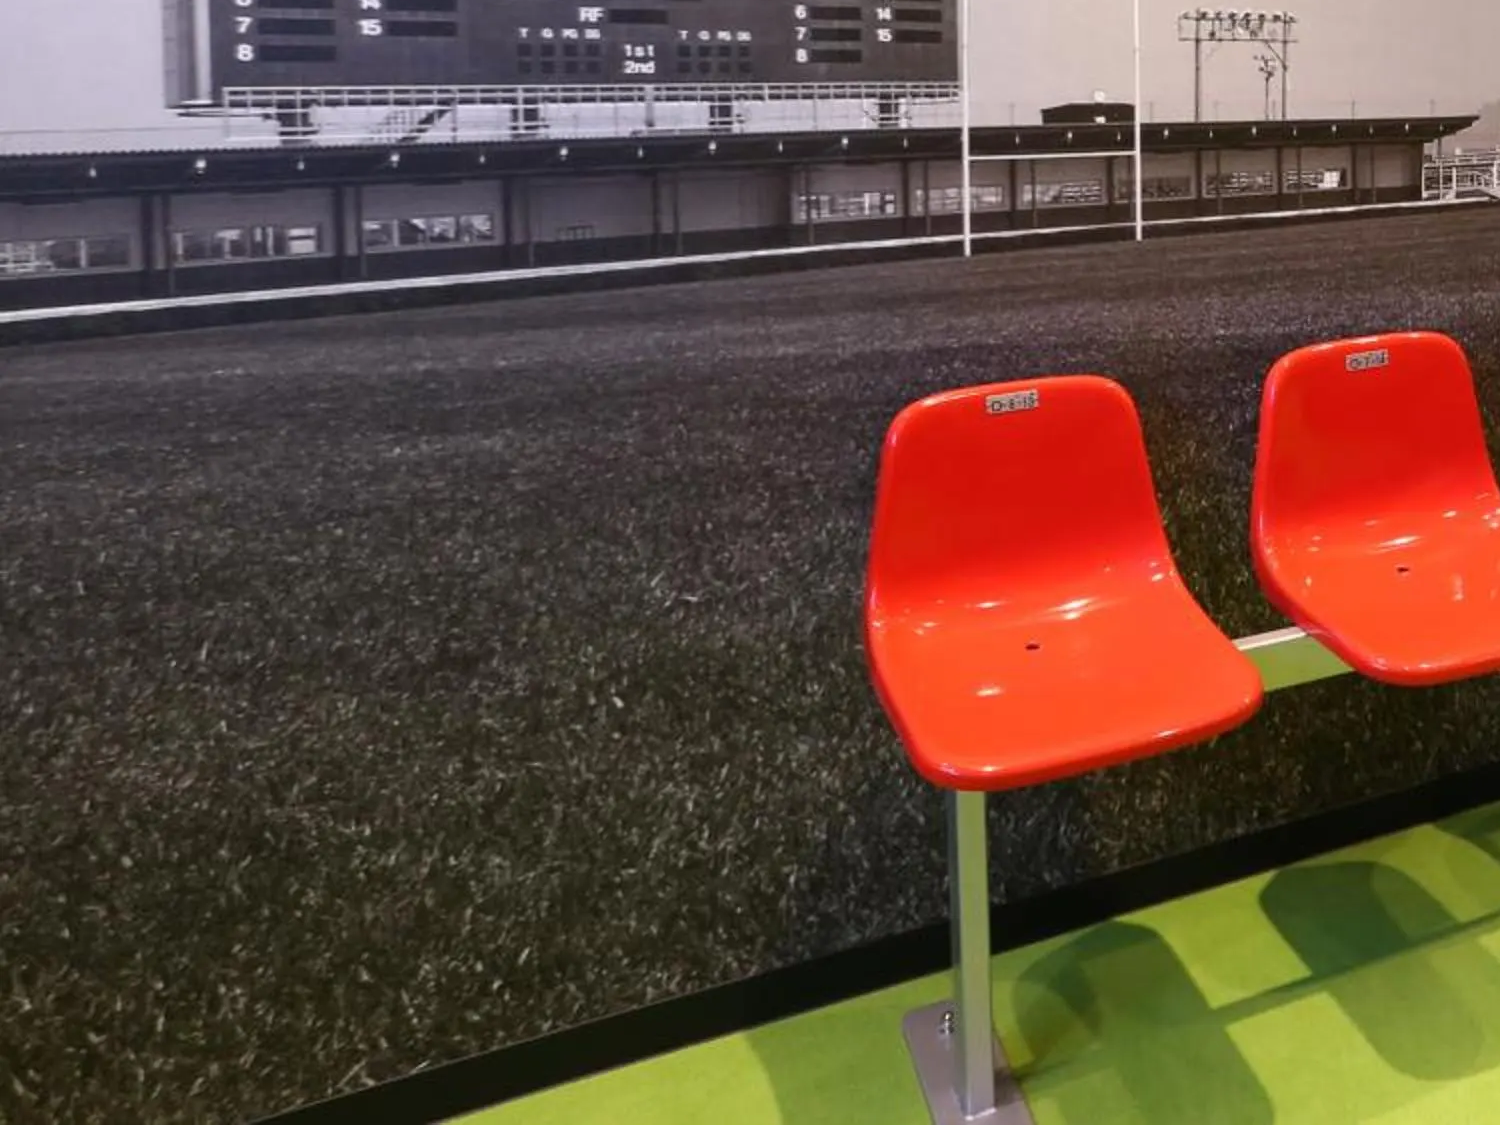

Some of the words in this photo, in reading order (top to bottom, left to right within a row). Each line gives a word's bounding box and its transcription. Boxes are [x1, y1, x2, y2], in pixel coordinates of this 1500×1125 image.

[579, 6, 603, 23] RF
[794, 4, 807, 20] 6
[876, 7, 892, 20] 14
[235, 16, 253, 34] 7
[358, 19, 382, 36] 15
[519, 27, 529, 38] T
[679, 30, 689, 40] T
[795, 26, 807, 41] 7
[876, 28, 893, 42] 15
[236, 43, 254, 62] 8
[624, 44, 654, 58] 1st
[796, 48, 808, 63] 8
[624, 60, 655, 74] 2nd
